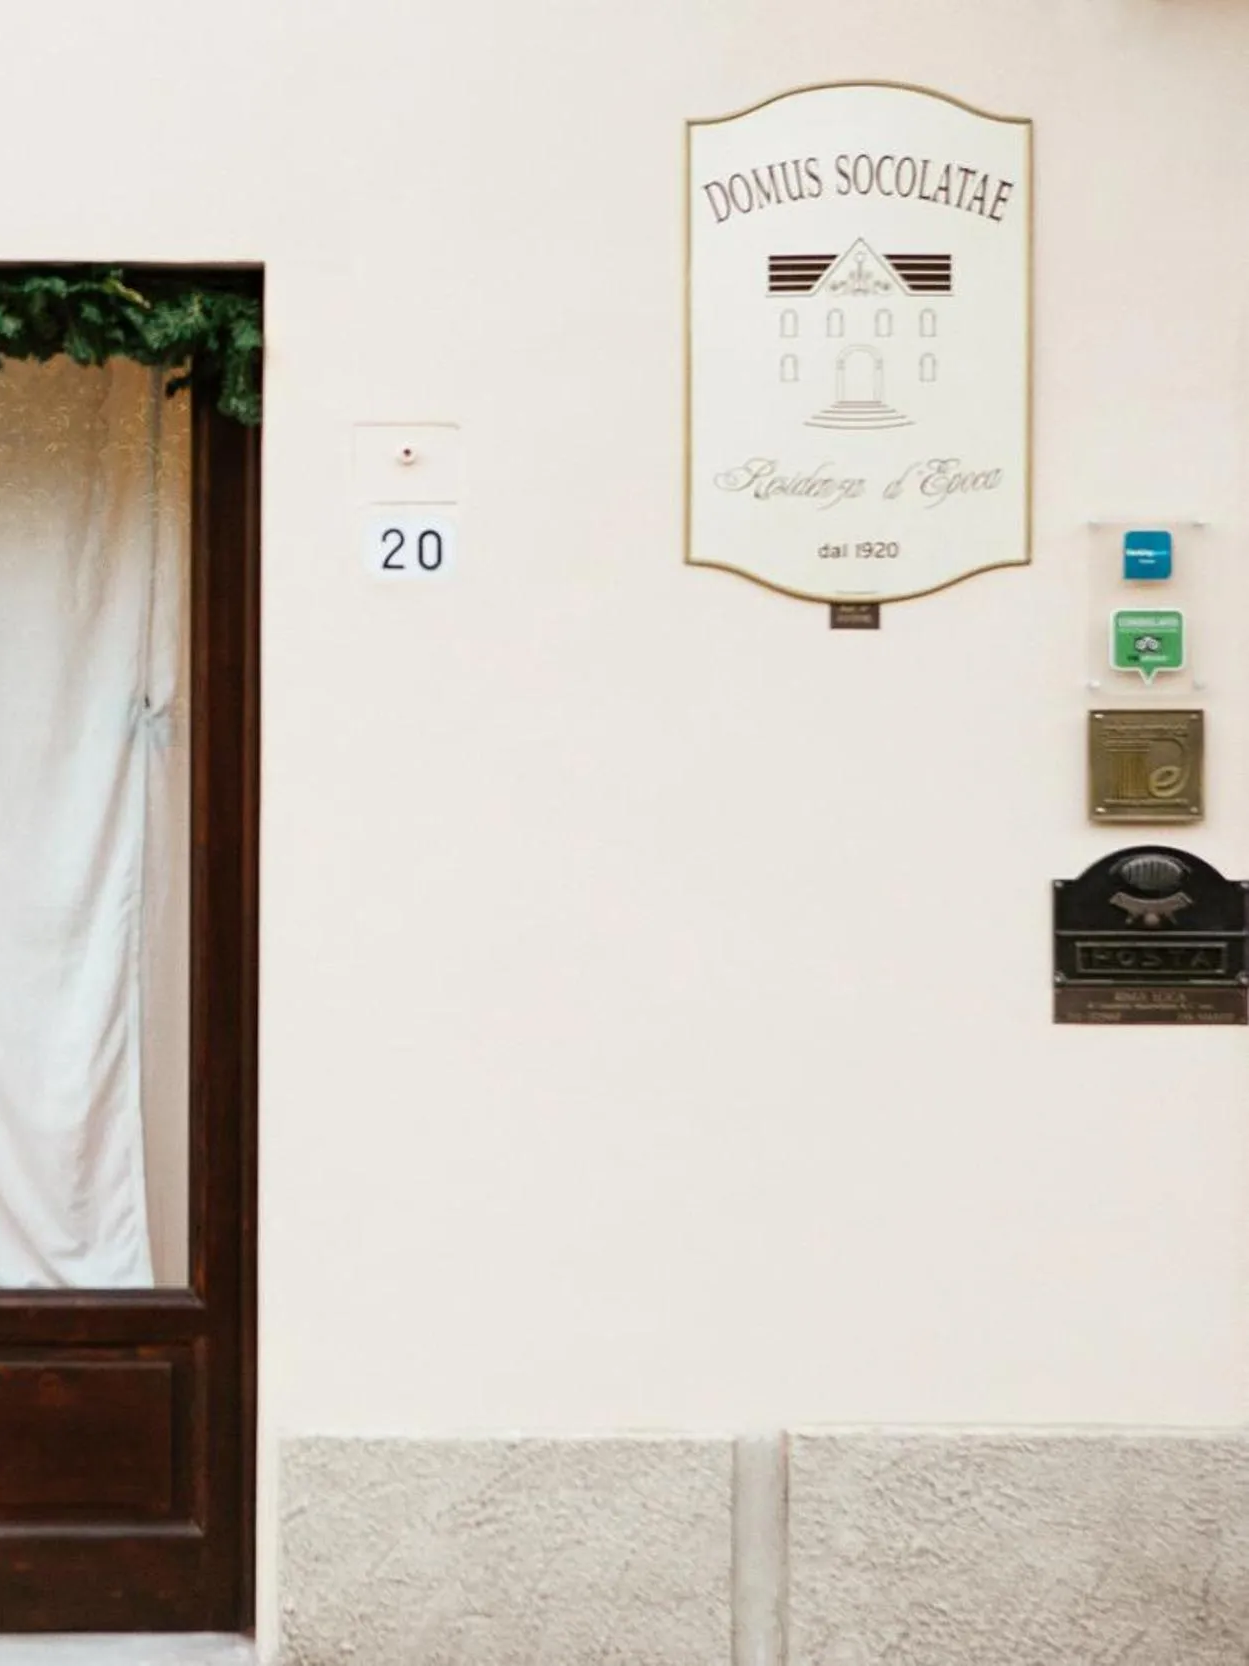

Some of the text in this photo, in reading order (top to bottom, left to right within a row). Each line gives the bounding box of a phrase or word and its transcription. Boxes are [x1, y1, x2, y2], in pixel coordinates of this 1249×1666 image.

[702, 154, 1014, 223] DOMUS SOCOLATAE
[381, 528, 443, 571] 20
[817, 541, 901, 559] dal 1920
